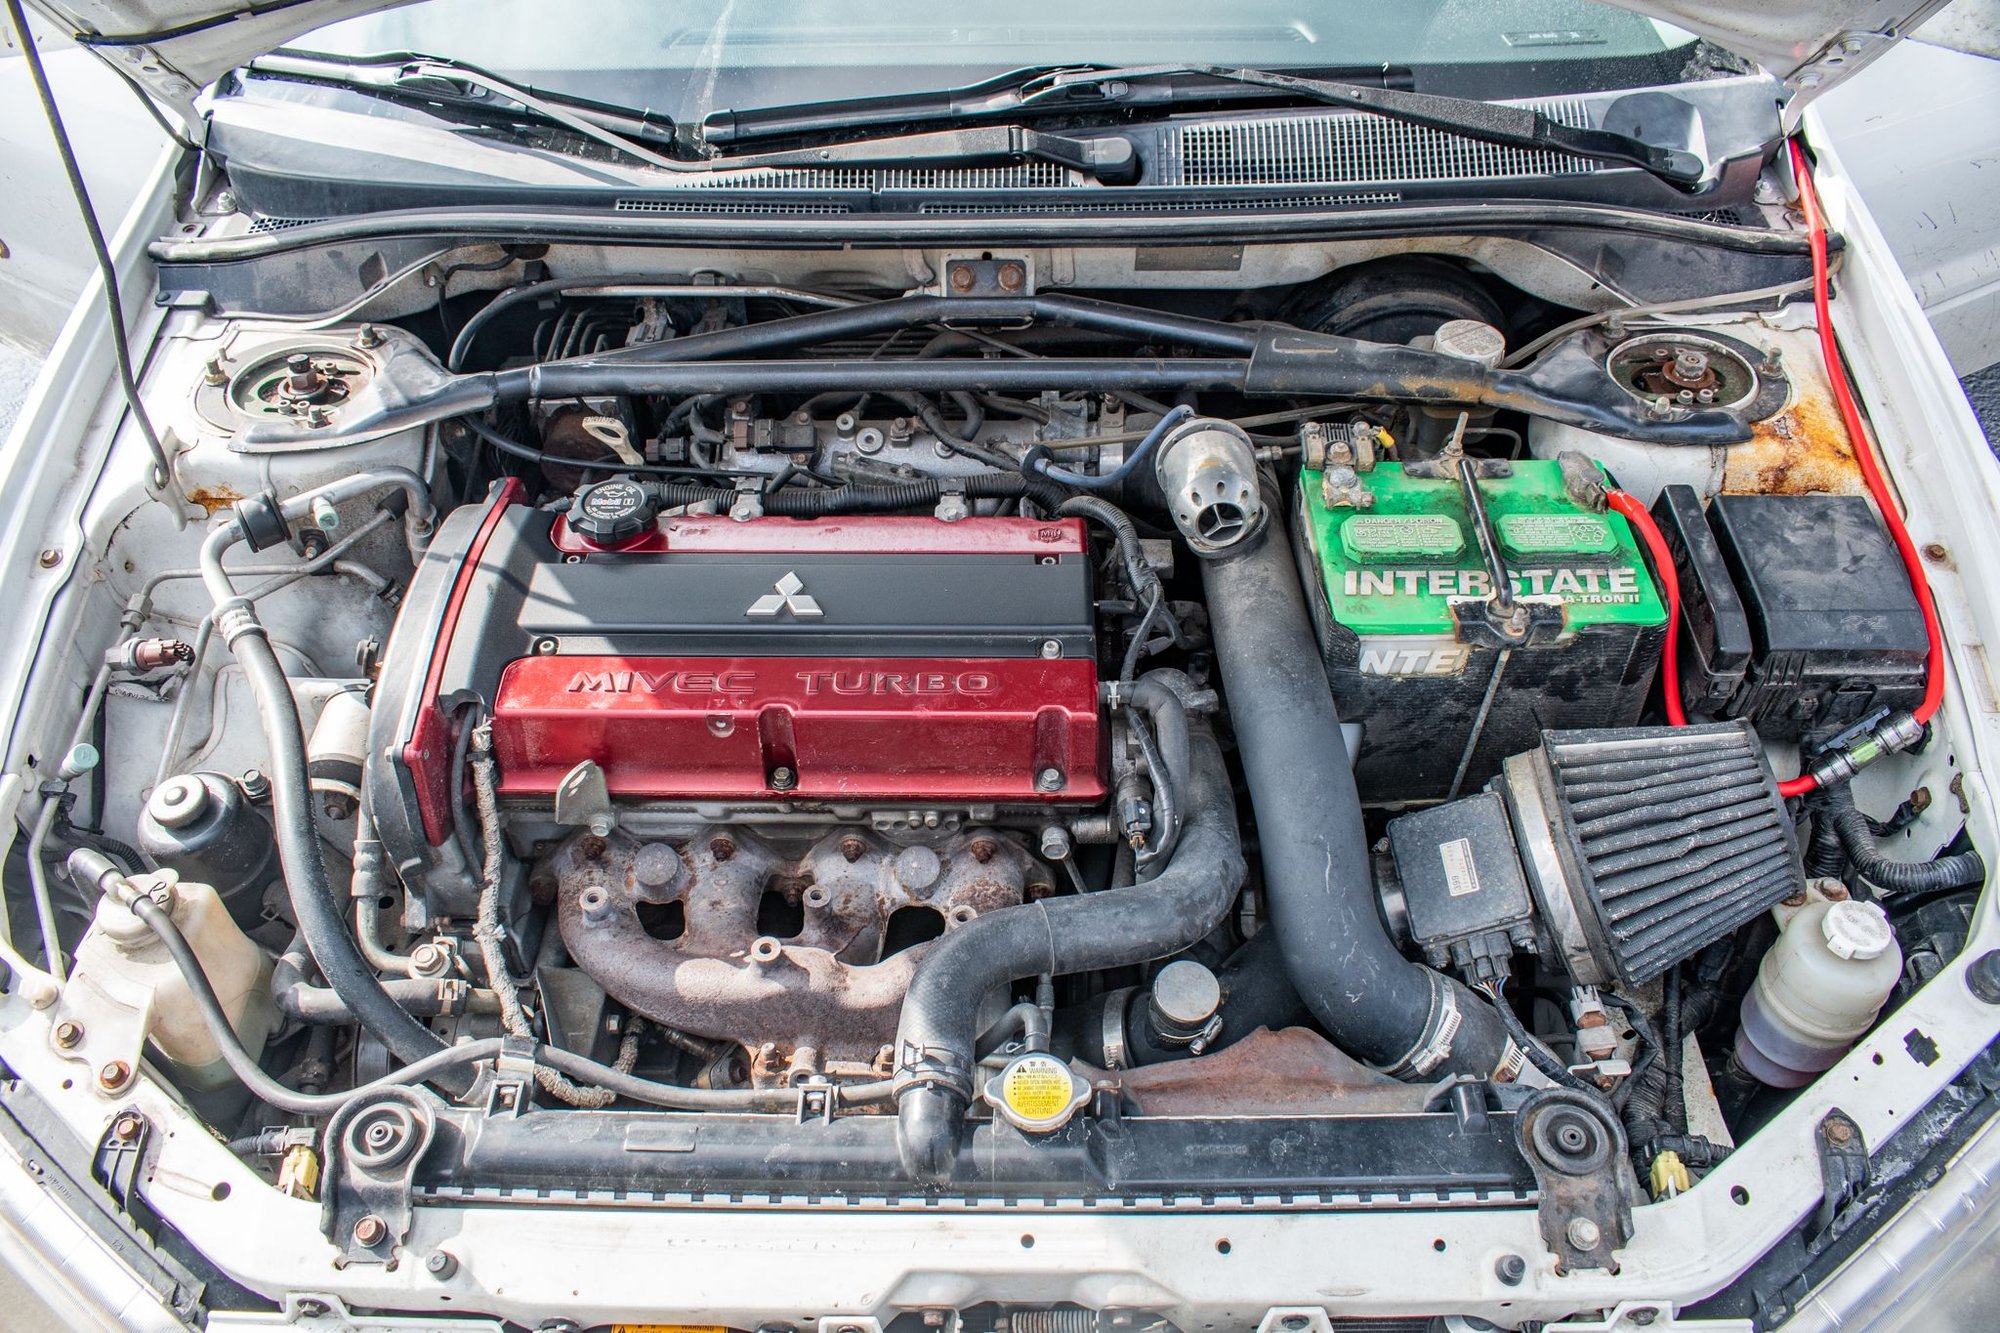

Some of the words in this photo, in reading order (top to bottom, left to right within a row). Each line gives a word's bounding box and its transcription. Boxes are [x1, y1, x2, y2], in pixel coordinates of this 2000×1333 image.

[594, 484, 624, 494] ENGINE
[1565, 594, 1625, 603] A-TRON
[568, 671, 760, 694] MIVEC
[797, 671, 999, 695] TURBO
